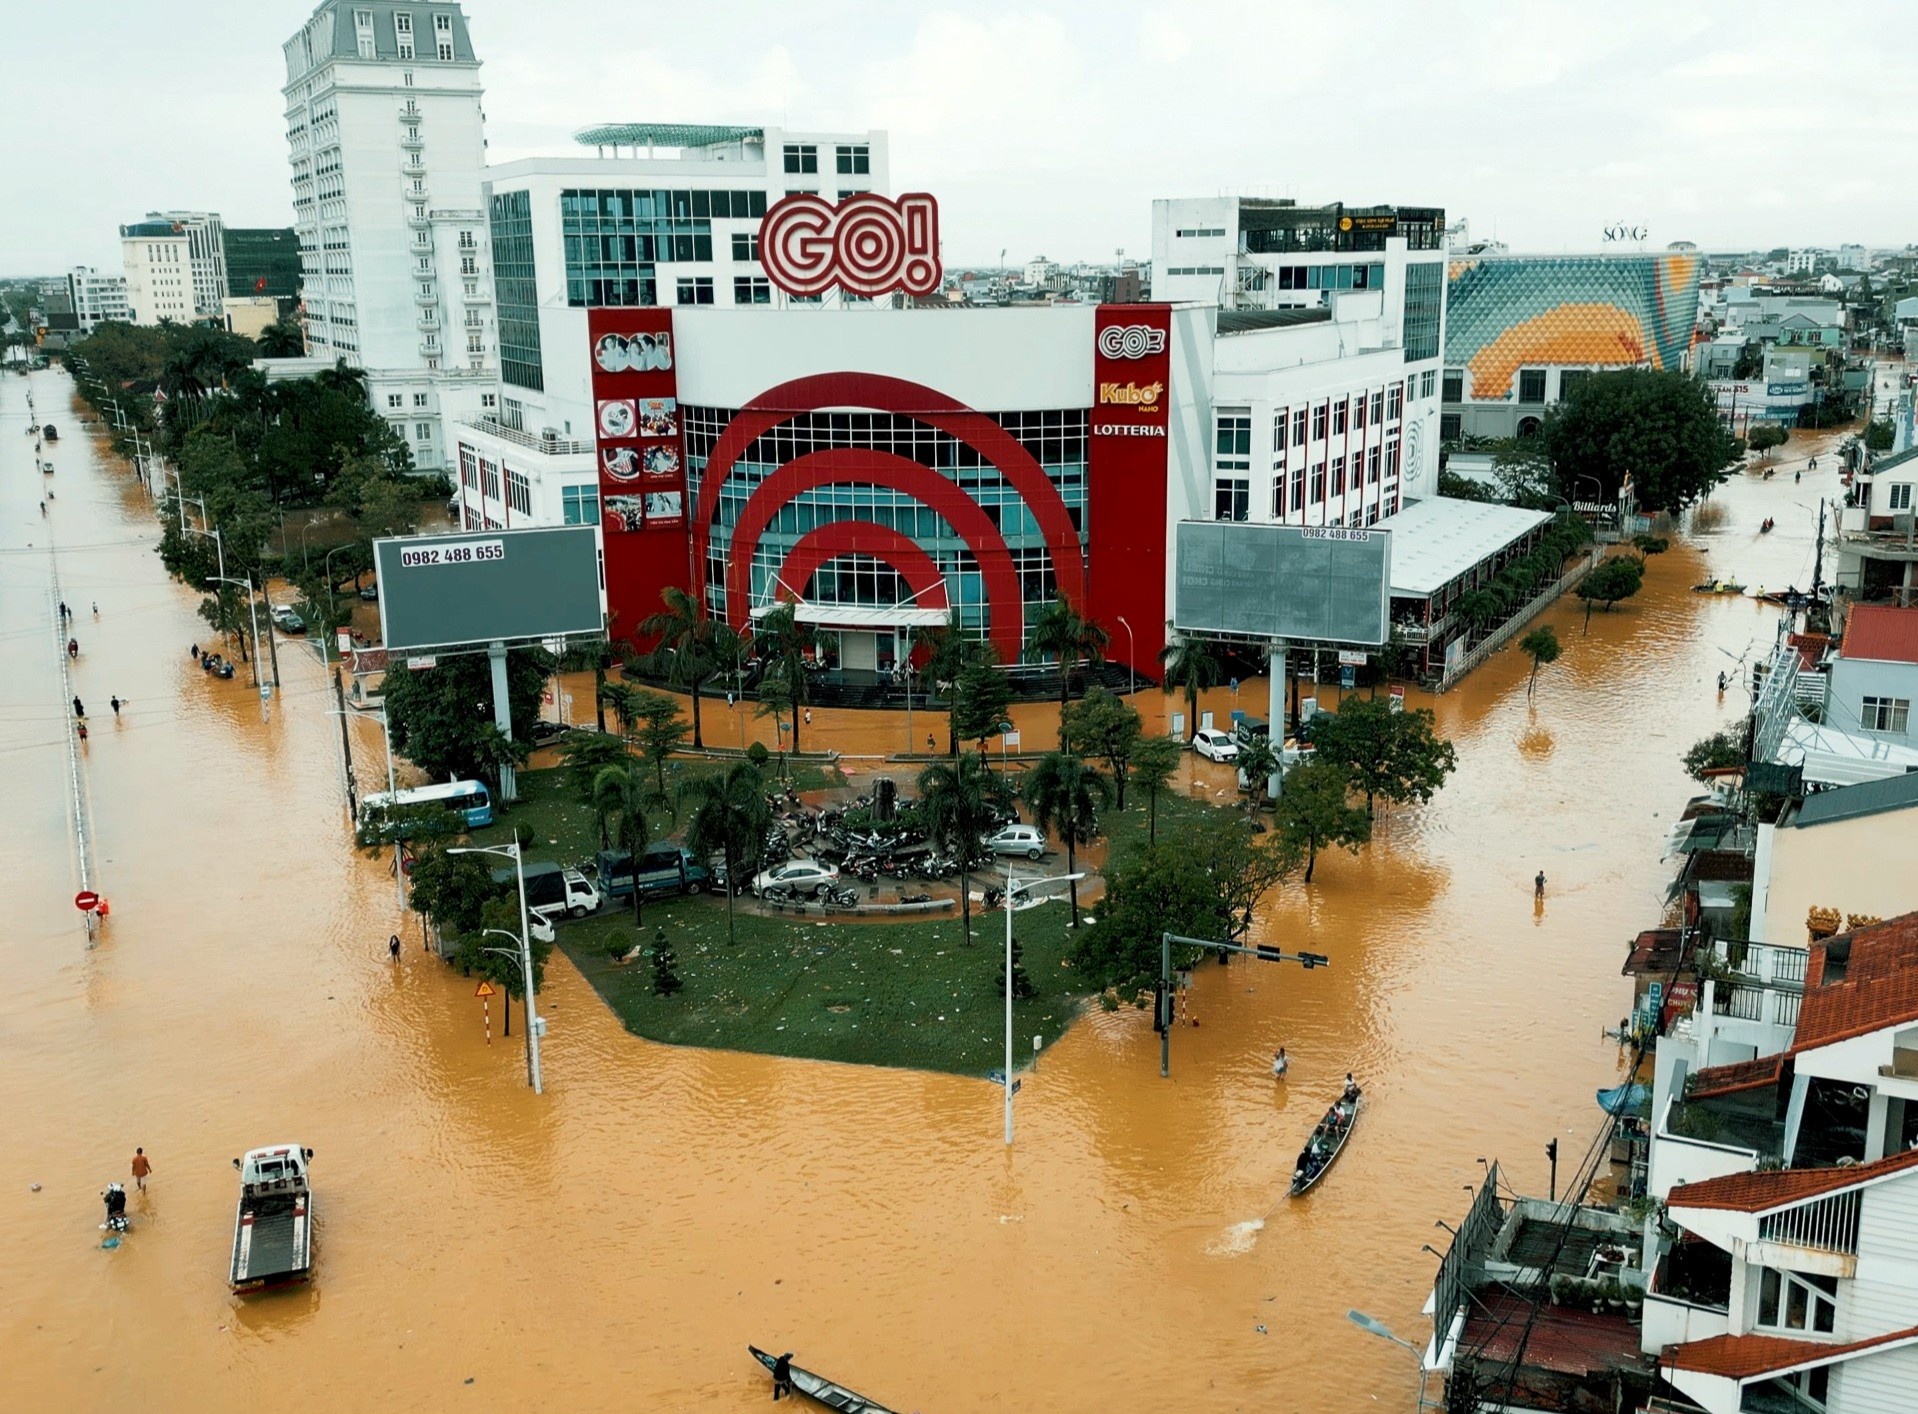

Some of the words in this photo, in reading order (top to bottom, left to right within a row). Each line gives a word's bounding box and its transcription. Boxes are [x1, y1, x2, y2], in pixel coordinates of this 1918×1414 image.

[758, 192, 942, 297] GO!
[1094, 424, 1166, 437] LOTTERIA
[1572, 500, 1617, 513] Billiards
[1302, 528, 1327, 539] 0982
[1329, 529, 1347, 540] 488
[1349, 530, 1369, 541] 655
[402, 550, 440, 566] 0982
[444, 547, 472, 562] 488
[475, 545, 503, 560] 655
